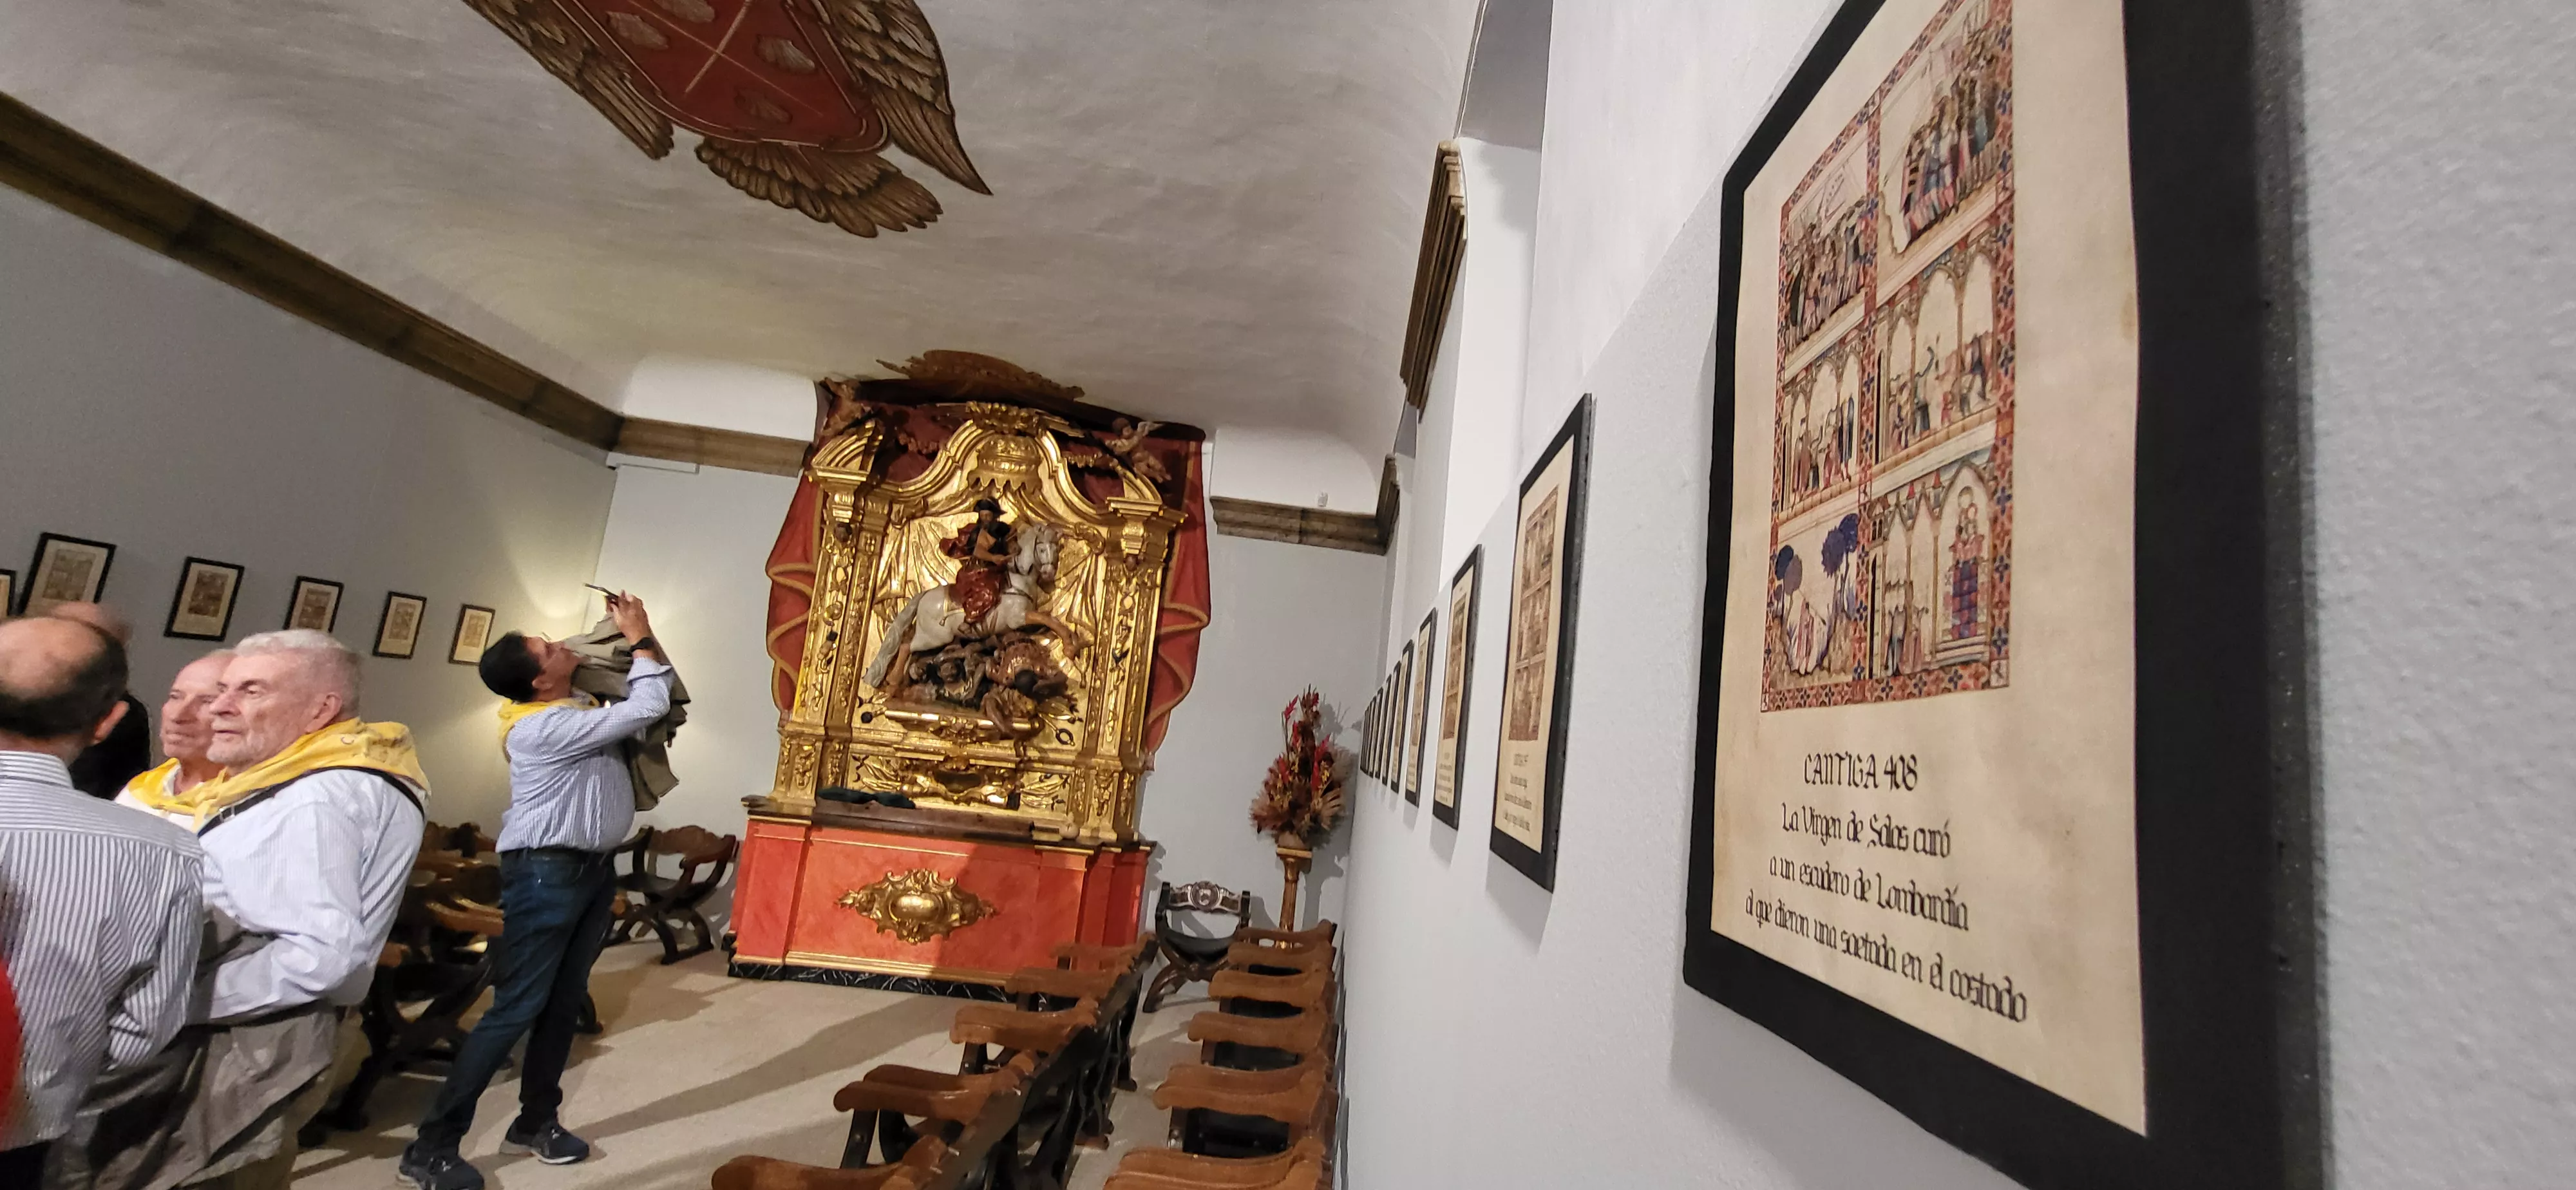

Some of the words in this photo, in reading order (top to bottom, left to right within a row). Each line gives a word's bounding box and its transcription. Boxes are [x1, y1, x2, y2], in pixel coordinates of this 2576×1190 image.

[1804, 751, 1879, 789] CANTIGA
[1884, 754, 1918, 791] 408
[1781, 802, 1799, 832] La
[1801, 805, 1842, 847] Virgen
[1846, 809, 1864, 843] de
[1868, 813, 1909, 851] Salas
[1913, 818, 1951, 858] curó
[1770, 855, 1777, 877] a
[1779, 857, 1795, 882] un
[1799, 860, 1850, 896] escudero
[1853, 867, 1872, 903] de
[1875, 872, 1969, 931] Lombardía
[1755, 899, 1773, 929] que
[1774, 898, 1810, 938] dieron
[1814, 918, 1837, 950] una
[1841, 932, 1897, 973] saetada
[1901, 951, 1924, 983] en
[1929, 952, 1944, 992] el
[1949, 968, 2027, 1023] costado
